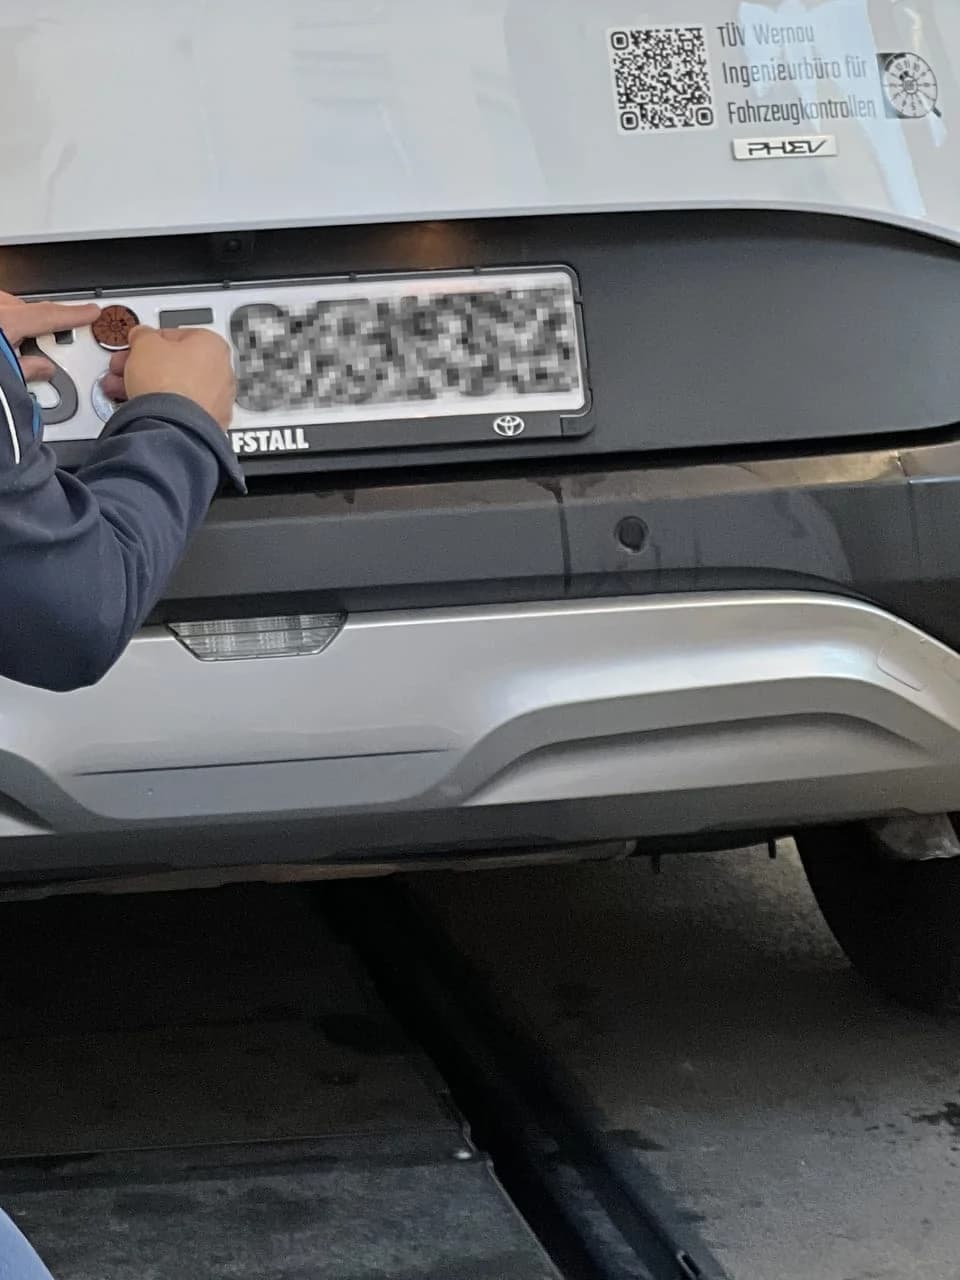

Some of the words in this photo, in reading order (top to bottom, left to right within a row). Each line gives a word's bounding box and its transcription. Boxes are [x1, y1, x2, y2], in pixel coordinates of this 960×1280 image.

[717, 22, 745, 47] TÜV
[753, 23, 815, 45] Wernau
[722, 57, 841, 88] Ingenieurbüro
[845, 55, 867, 78] für
[727, 95, 877, 126] Fahrzeugkontrollen
[747, 139, 827, 156] PHEV
[225, 428, 310, 453] FSTALL
